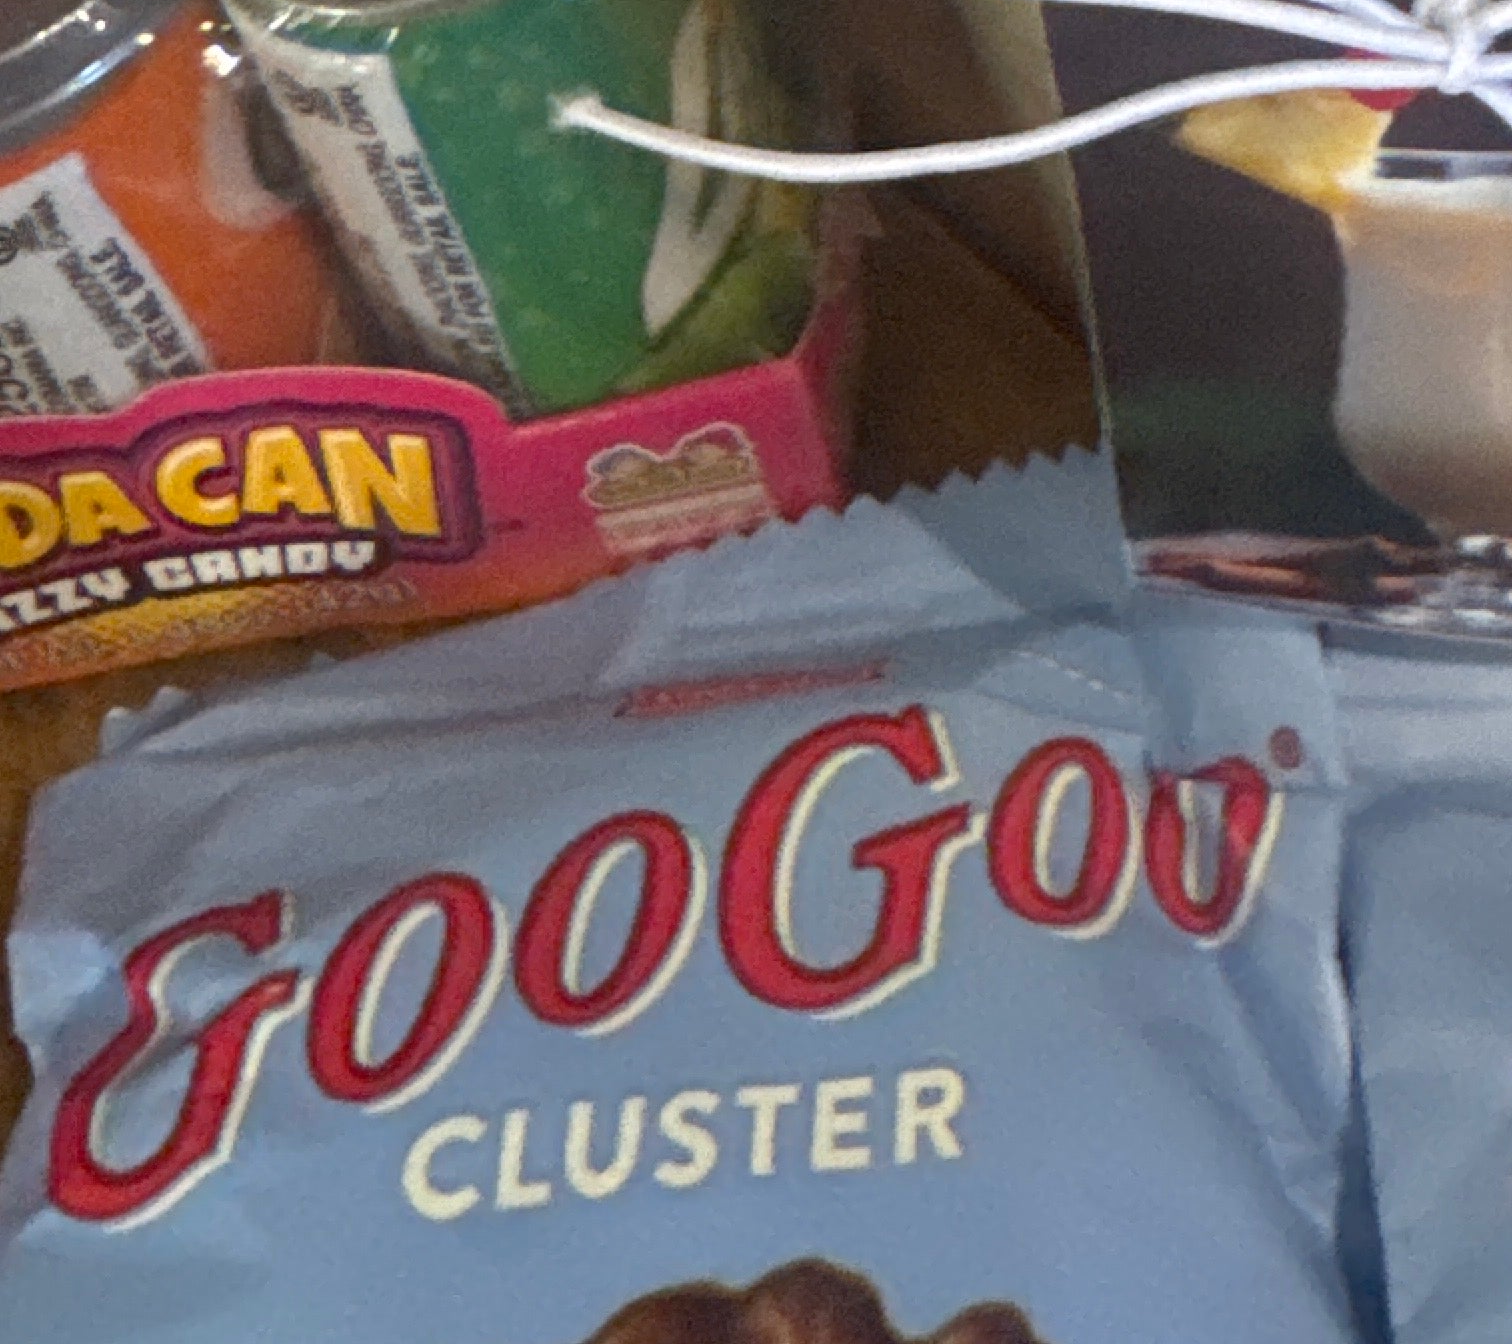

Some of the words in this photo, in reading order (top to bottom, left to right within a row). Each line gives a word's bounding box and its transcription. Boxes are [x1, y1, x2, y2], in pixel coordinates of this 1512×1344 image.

[155, 424, 442, 537] CAN
[142, 540, 377, 592] CANDY
[401, 1067, 967, 1222] CLUSTER
